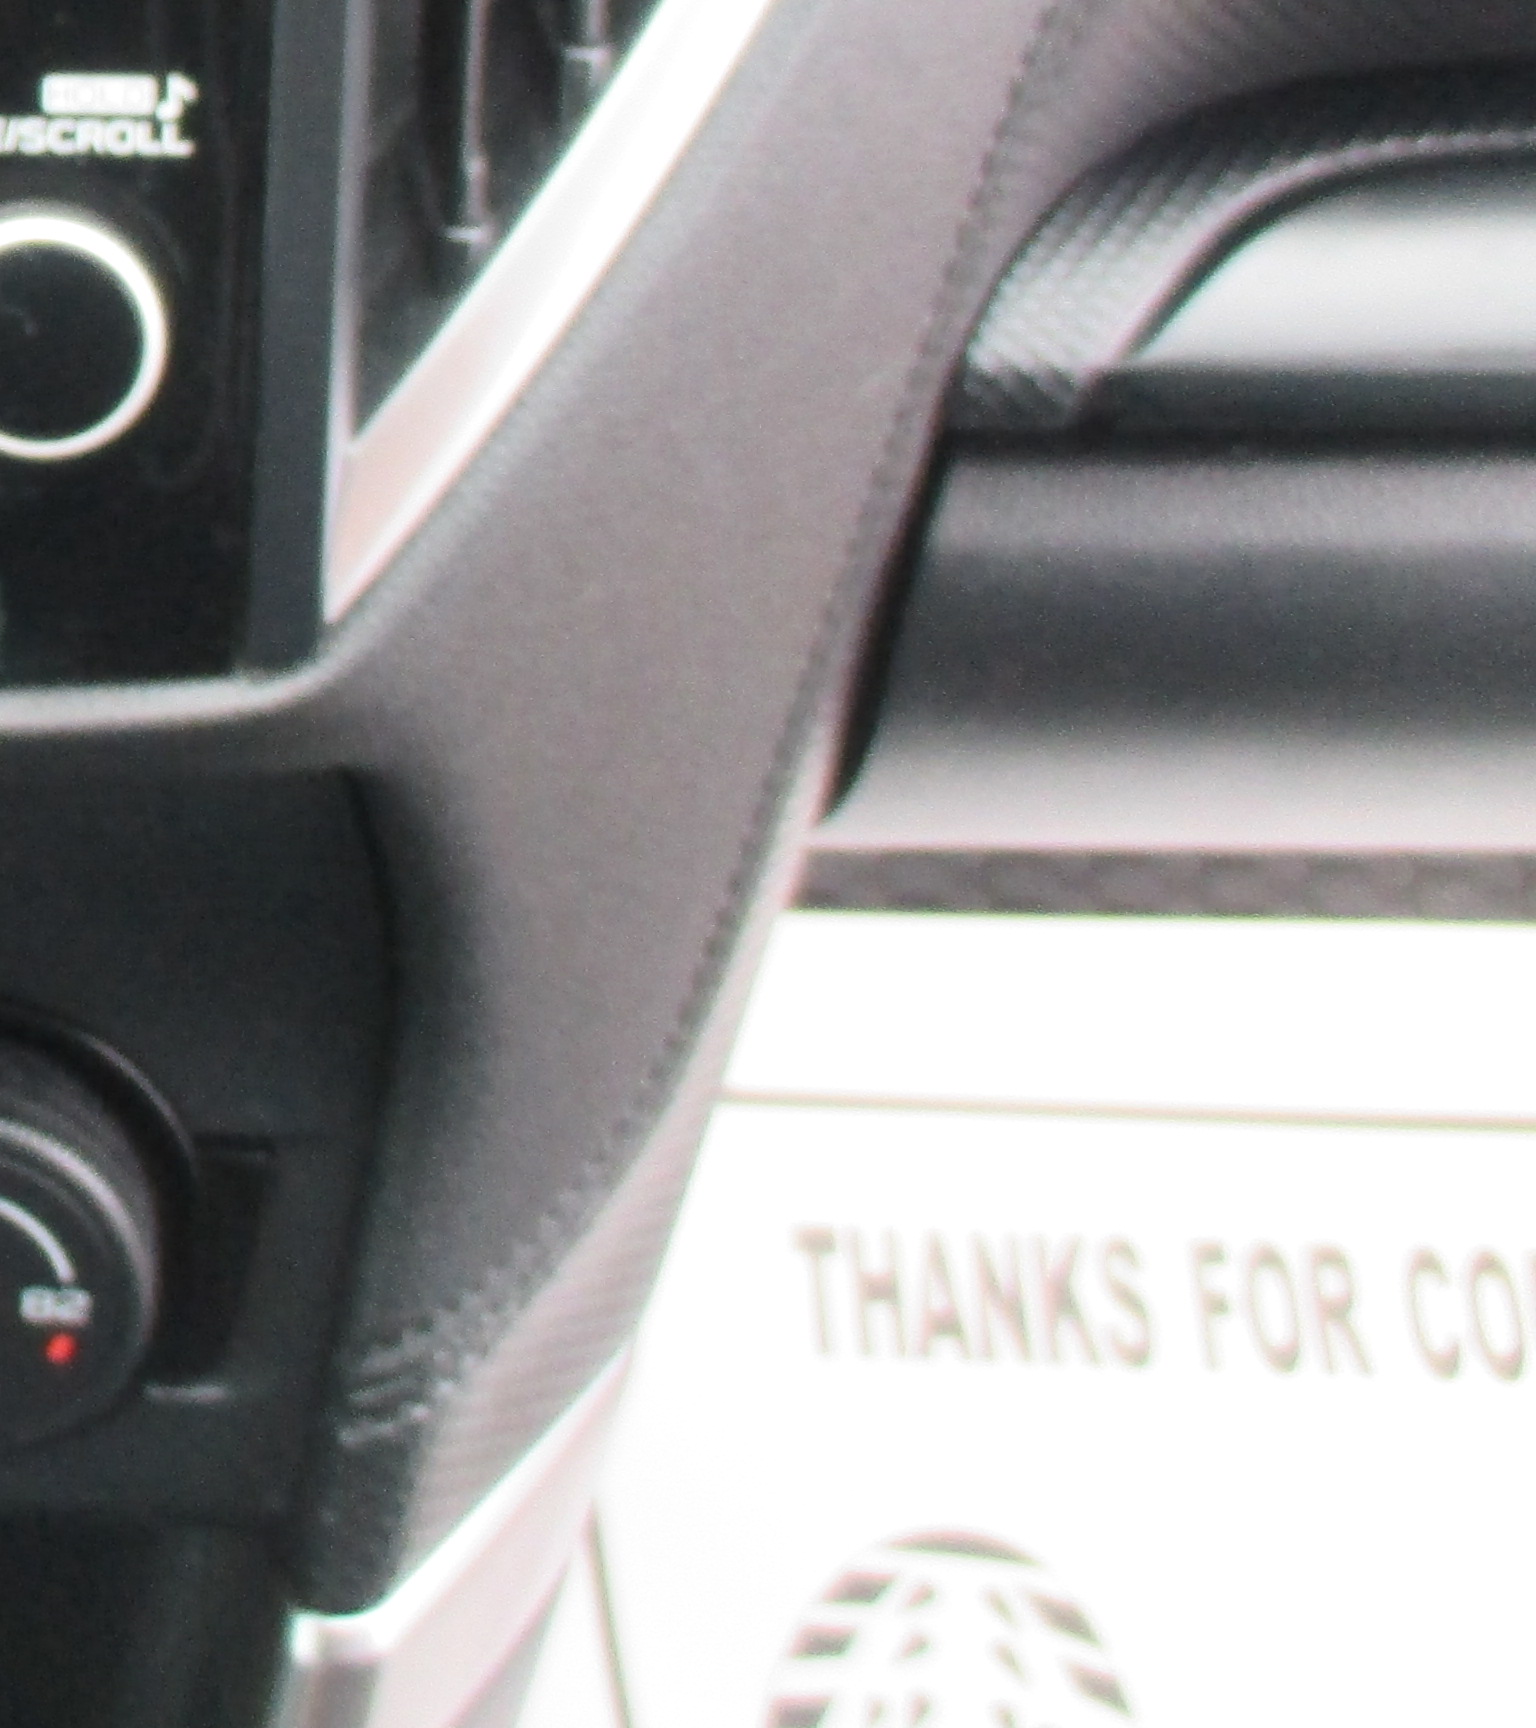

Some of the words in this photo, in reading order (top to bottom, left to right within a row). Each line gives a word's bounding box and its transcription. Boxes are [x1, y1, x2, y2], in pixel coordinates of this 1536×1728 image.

[792, 1224, 1154, 1370] THANKS
[1190, 1240, 1374, 1376] FOR
[1402, 1244, 1536, 1384] CO
